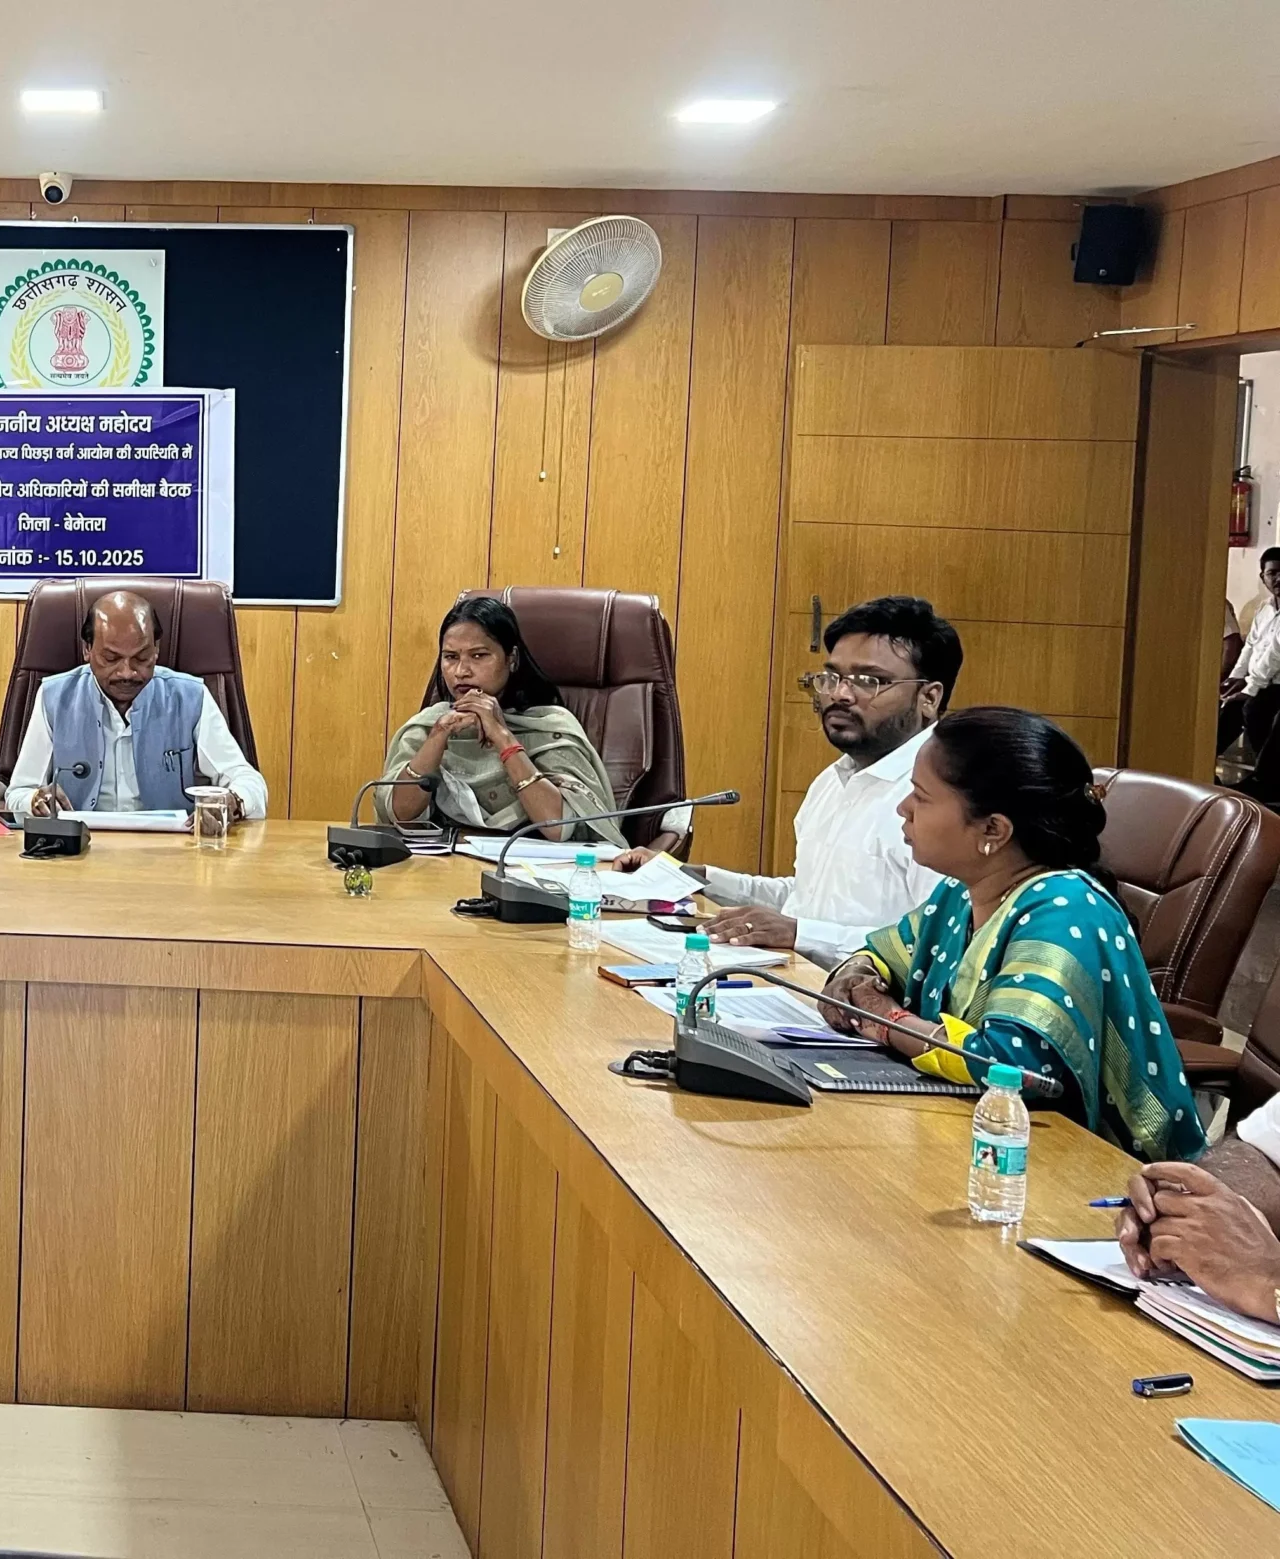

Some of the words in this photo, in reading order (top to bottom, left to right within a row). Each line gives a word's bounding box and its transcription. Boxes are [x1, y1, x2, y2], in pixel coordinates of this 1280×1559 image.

[12, 274, 80, 311] छत्तीसगढ़
[85, 276, 127, 313] शासन
[45, 415, 95, 433] अध्यक्ष
[99, 410, 152, 433] महोदय
[21, 443, 53, 462] पिछड़ा
[55, 443, 74, 460] वर्ग
[76, 443, 113, 460] आयोग
[116, 443, 132, 460] की
[134, 443, 179, 460] उपस्थिति
[181, 443, 193, 460] में
[17, 478, 88, 498] अधिकारियों
[91, 478, 110, 498] की
[112, 478, 156, 498] समीक्षा
[159, 477, 192, 498] बैठक
[18, 512, 51, 532] जिला
[63, 512, 107, 532] बेमेतरा
[54, 549, 144, 566] 15.10.2025
